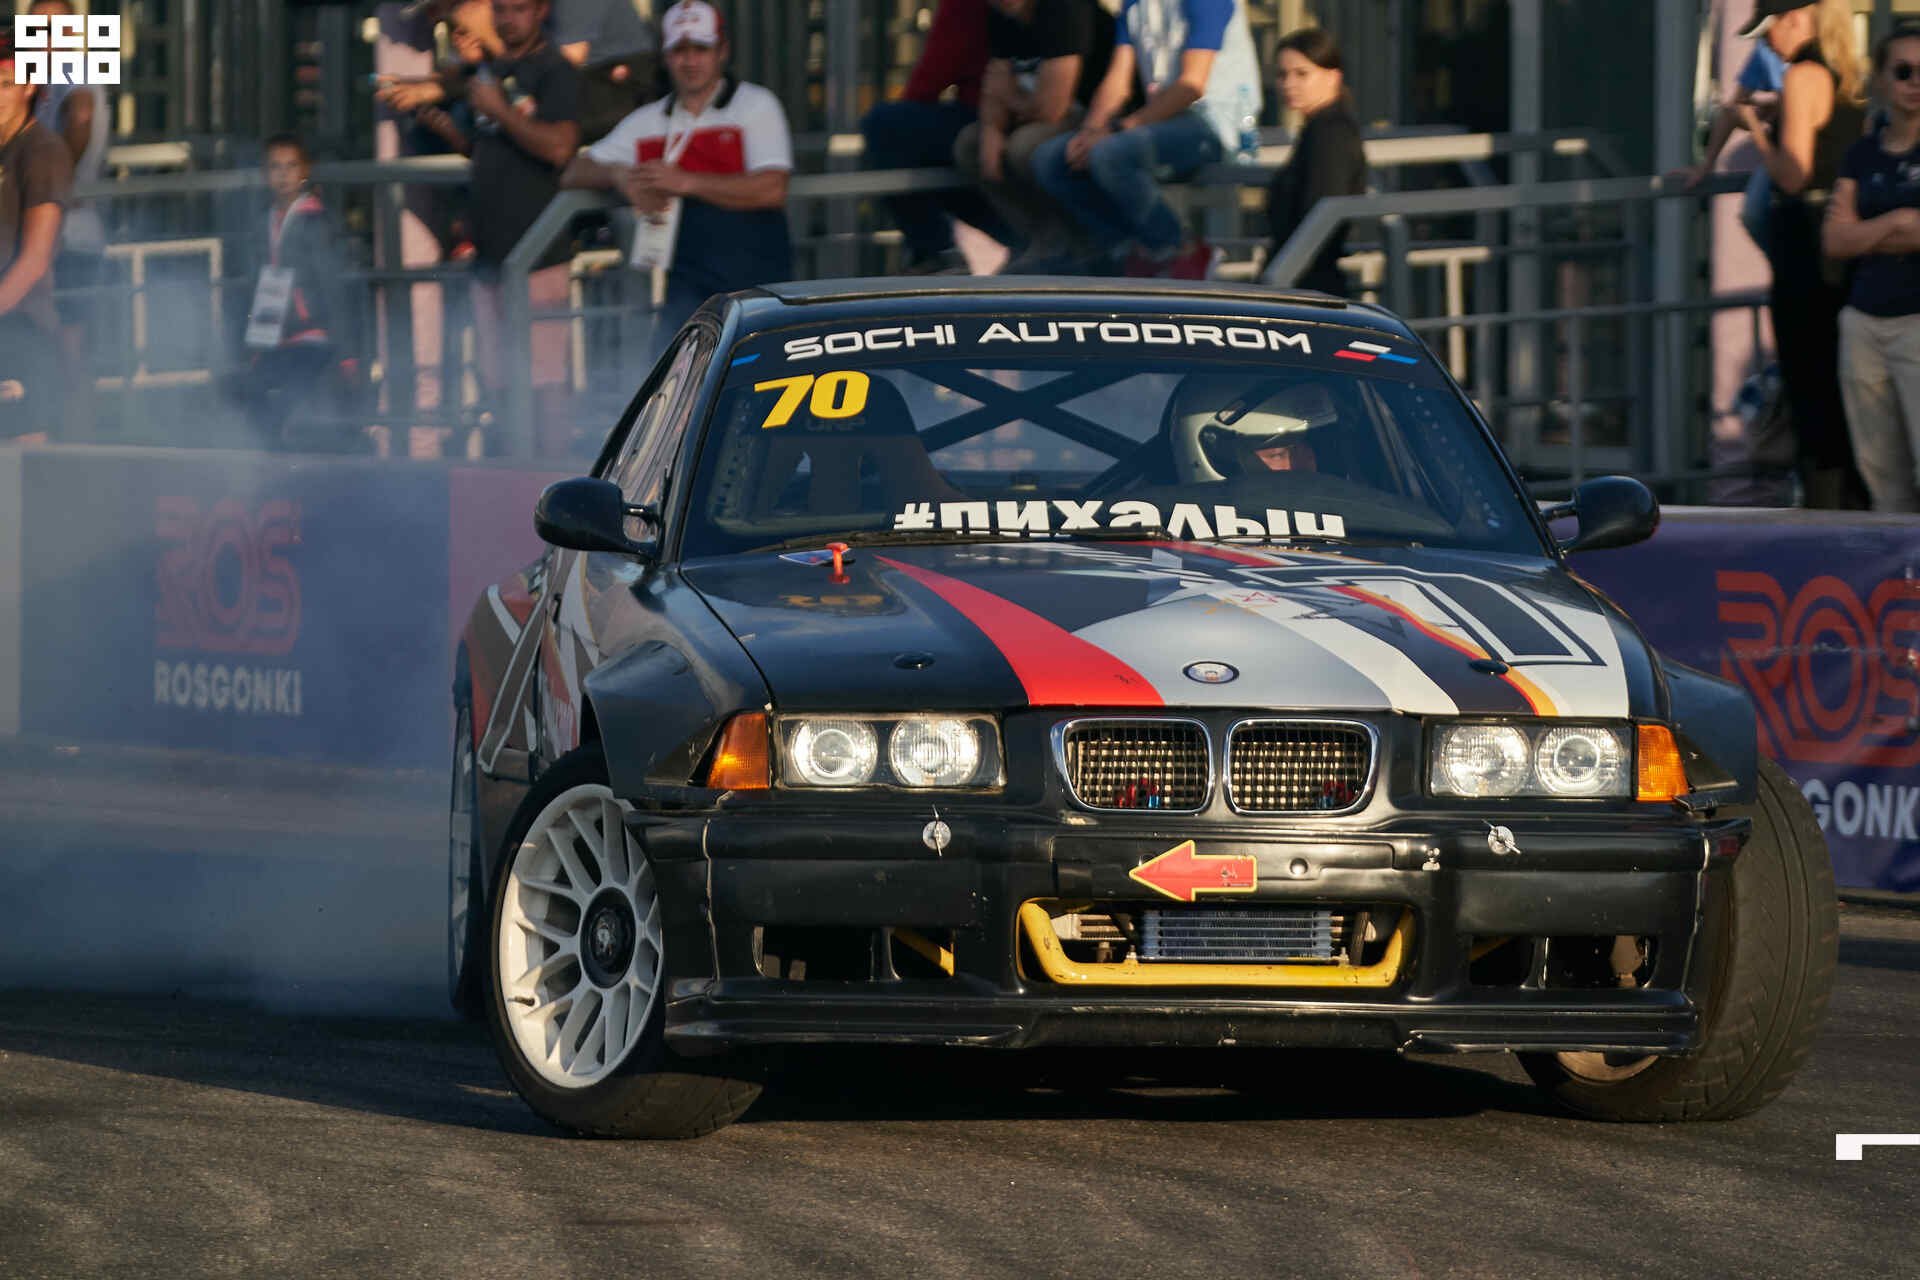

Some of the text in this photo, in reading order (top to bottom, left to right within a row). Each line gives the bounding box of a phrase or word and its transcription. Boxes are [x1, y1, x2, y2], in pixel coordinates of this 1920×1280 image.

[784, 322, 1312, 361] SOCHI AUTODROM
[754, 370, 870, 429] 70
[154, 659, 303, 715] ROSGONKI
